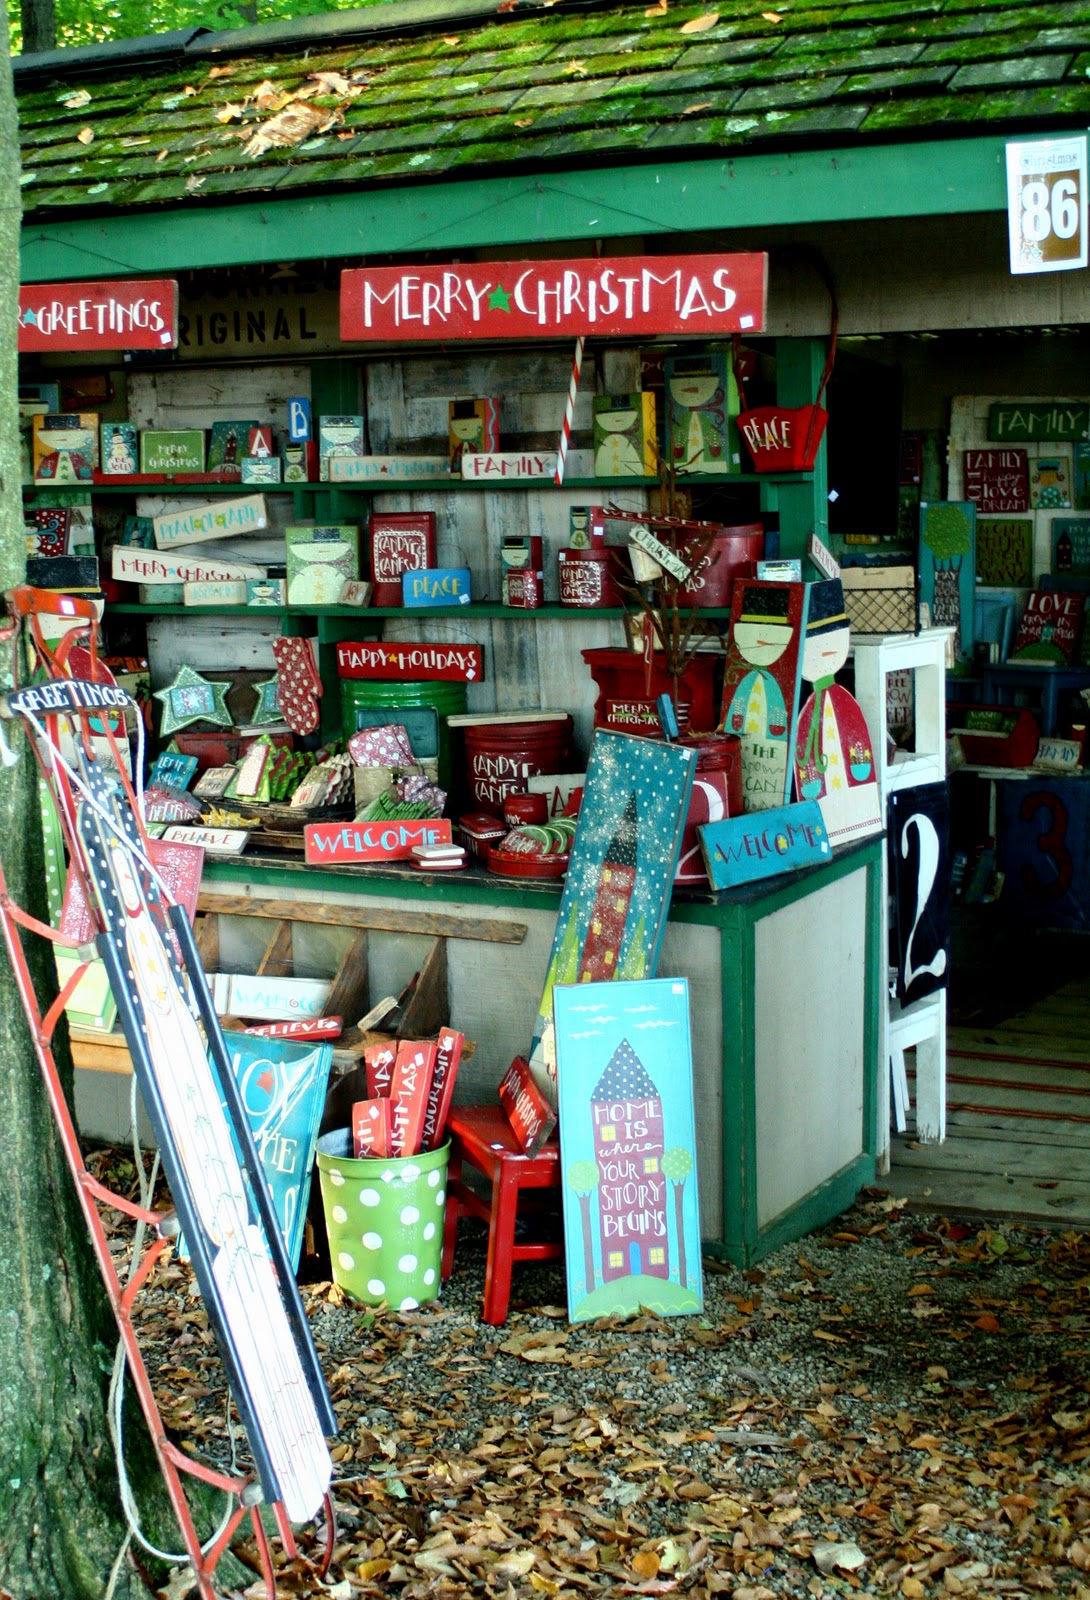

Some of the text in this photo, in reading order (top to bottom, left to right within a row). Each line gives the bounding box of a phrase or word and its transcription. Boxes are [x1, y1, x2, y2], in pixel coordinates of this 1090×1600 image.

[1021, 178, 1079, 242] 86
[363, 267, 737, 328] MERRY CHRISTMAS
[37, 297, 165, 335] GREETINGS
[178, 305, 317, 346] RIGINAL
[998, 408, 1084, 435] FAMILY
[251, 429, 271, 455] A
[742, 415, 793, 455] PEACE
[473, 457, 551, 477] FAMILY
[966, 451, 1025, 470] FAMILY
[982, 482, 1026, 499] love
[602, 507, 713, 528] WELCOME
[983, 499, 1026, 512] DREAM
[378, 534, 411, 554] CANDY
[120, 558, 171, 578] MERRY
[413, 575, 462, 599] PEACE
[1027, 592, 1082, 616] LOVE
[338, 649, 477, 671] HAPPY HOLIDAYS
[17, 680, 129, 711] GREETINGS
[611, 703, 652, 714] MERRY
[752, 742, 777, 760] THE
[472, 754, 522, 779] CANDY
[745, 776, 777, 793] CAN
[171, 829, 235, 846] BELIEVE
[312, 825, 441, 854] WELCOME
[715, 821, 821, 864] WELCOME
[901, 812, 947, 993] 2
[593, 1099, 662, 1127] HOME
[624, 1119, 650, 1140] IS
[597, 1141, 663, 1157] where
[597, 1159, 641, 1183] YOUR
[601, 1180, 666, 1212] STORY
[602, 1208, 668, 1239] BEGINS
